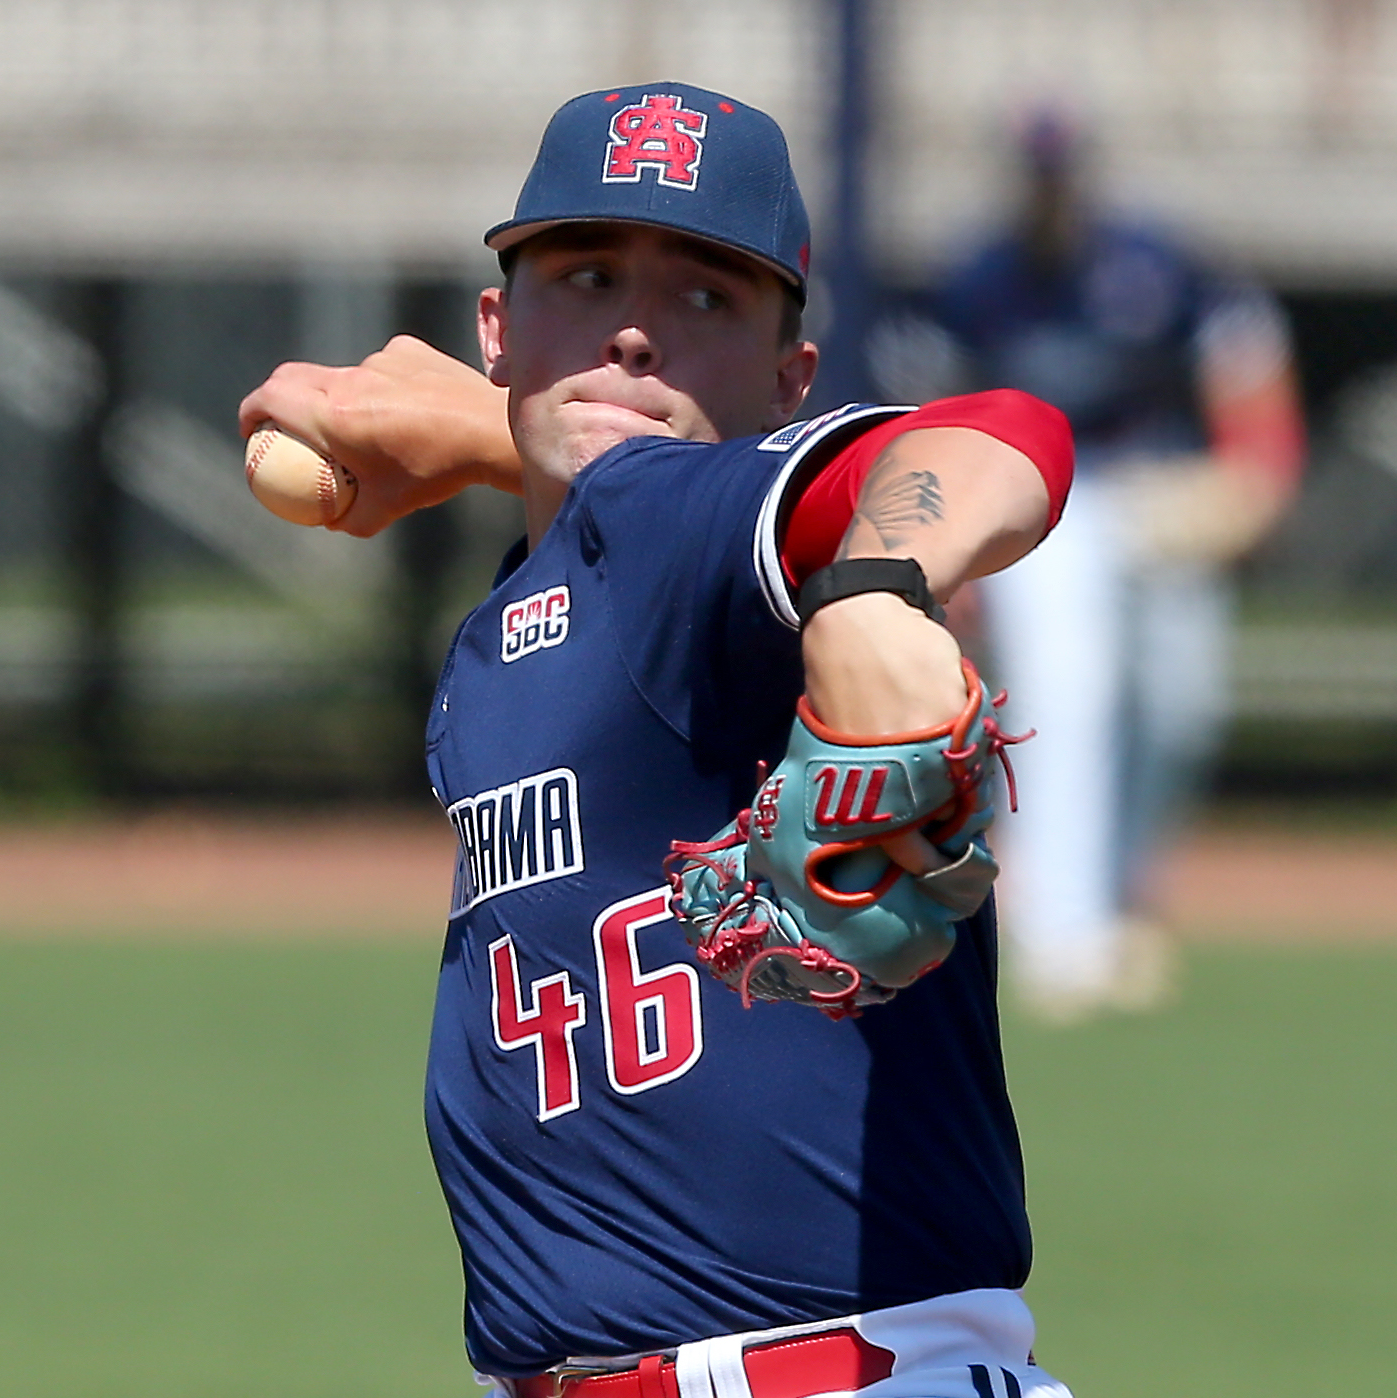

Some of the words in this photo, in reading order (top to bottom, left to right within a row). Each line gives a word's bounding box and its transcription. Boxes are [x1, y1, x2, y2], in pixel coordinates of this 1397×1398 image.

[502, 585, 571, 664] SBC
[448, 767, 585, 913] BAMA
[488, 884, 703, 1122] 46
